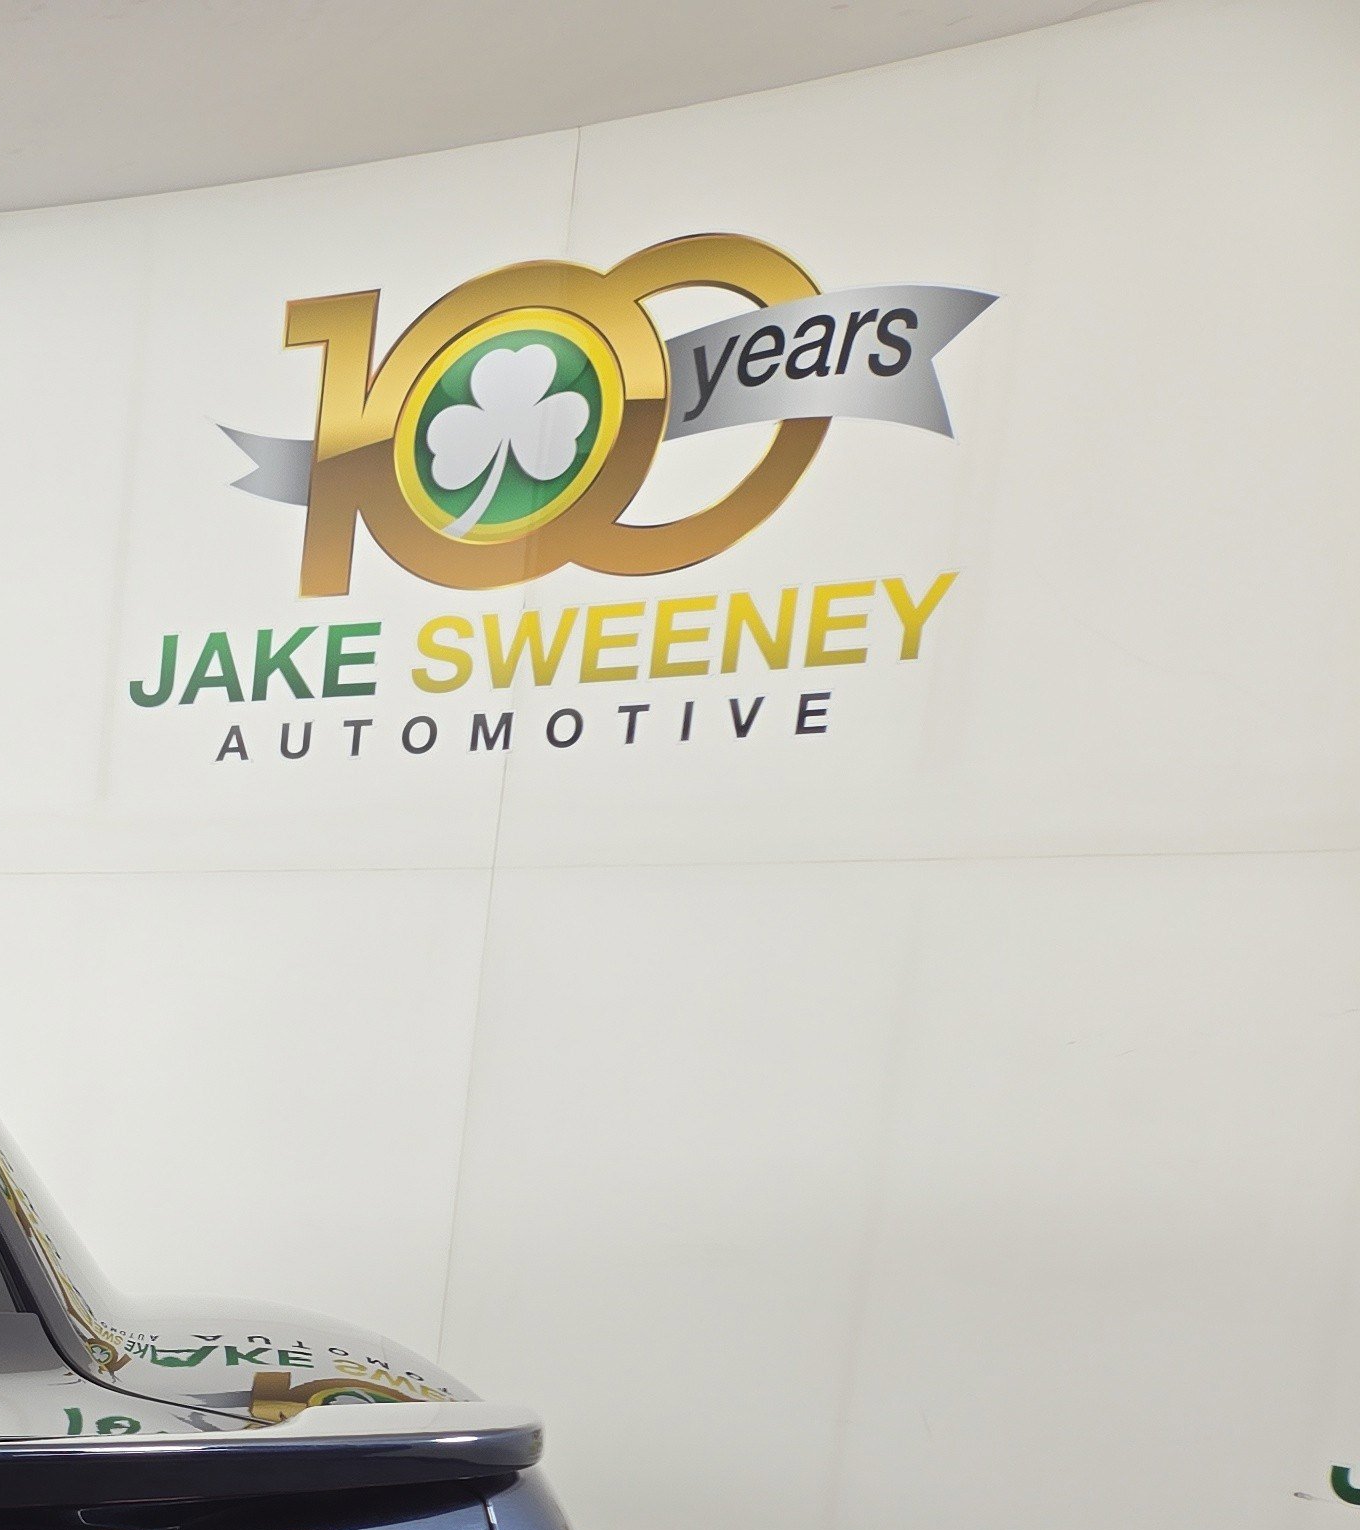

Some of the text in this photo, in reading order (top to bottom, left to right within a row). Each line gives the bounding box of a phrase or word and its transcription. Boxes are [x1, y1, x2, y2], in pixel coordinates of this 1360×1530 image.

[284, 232, 919, 598] 100 years
[129, 572, 959, 709] JAKE SWEENEY
[216, 691, 833, 763] AUTOMOTIVE
